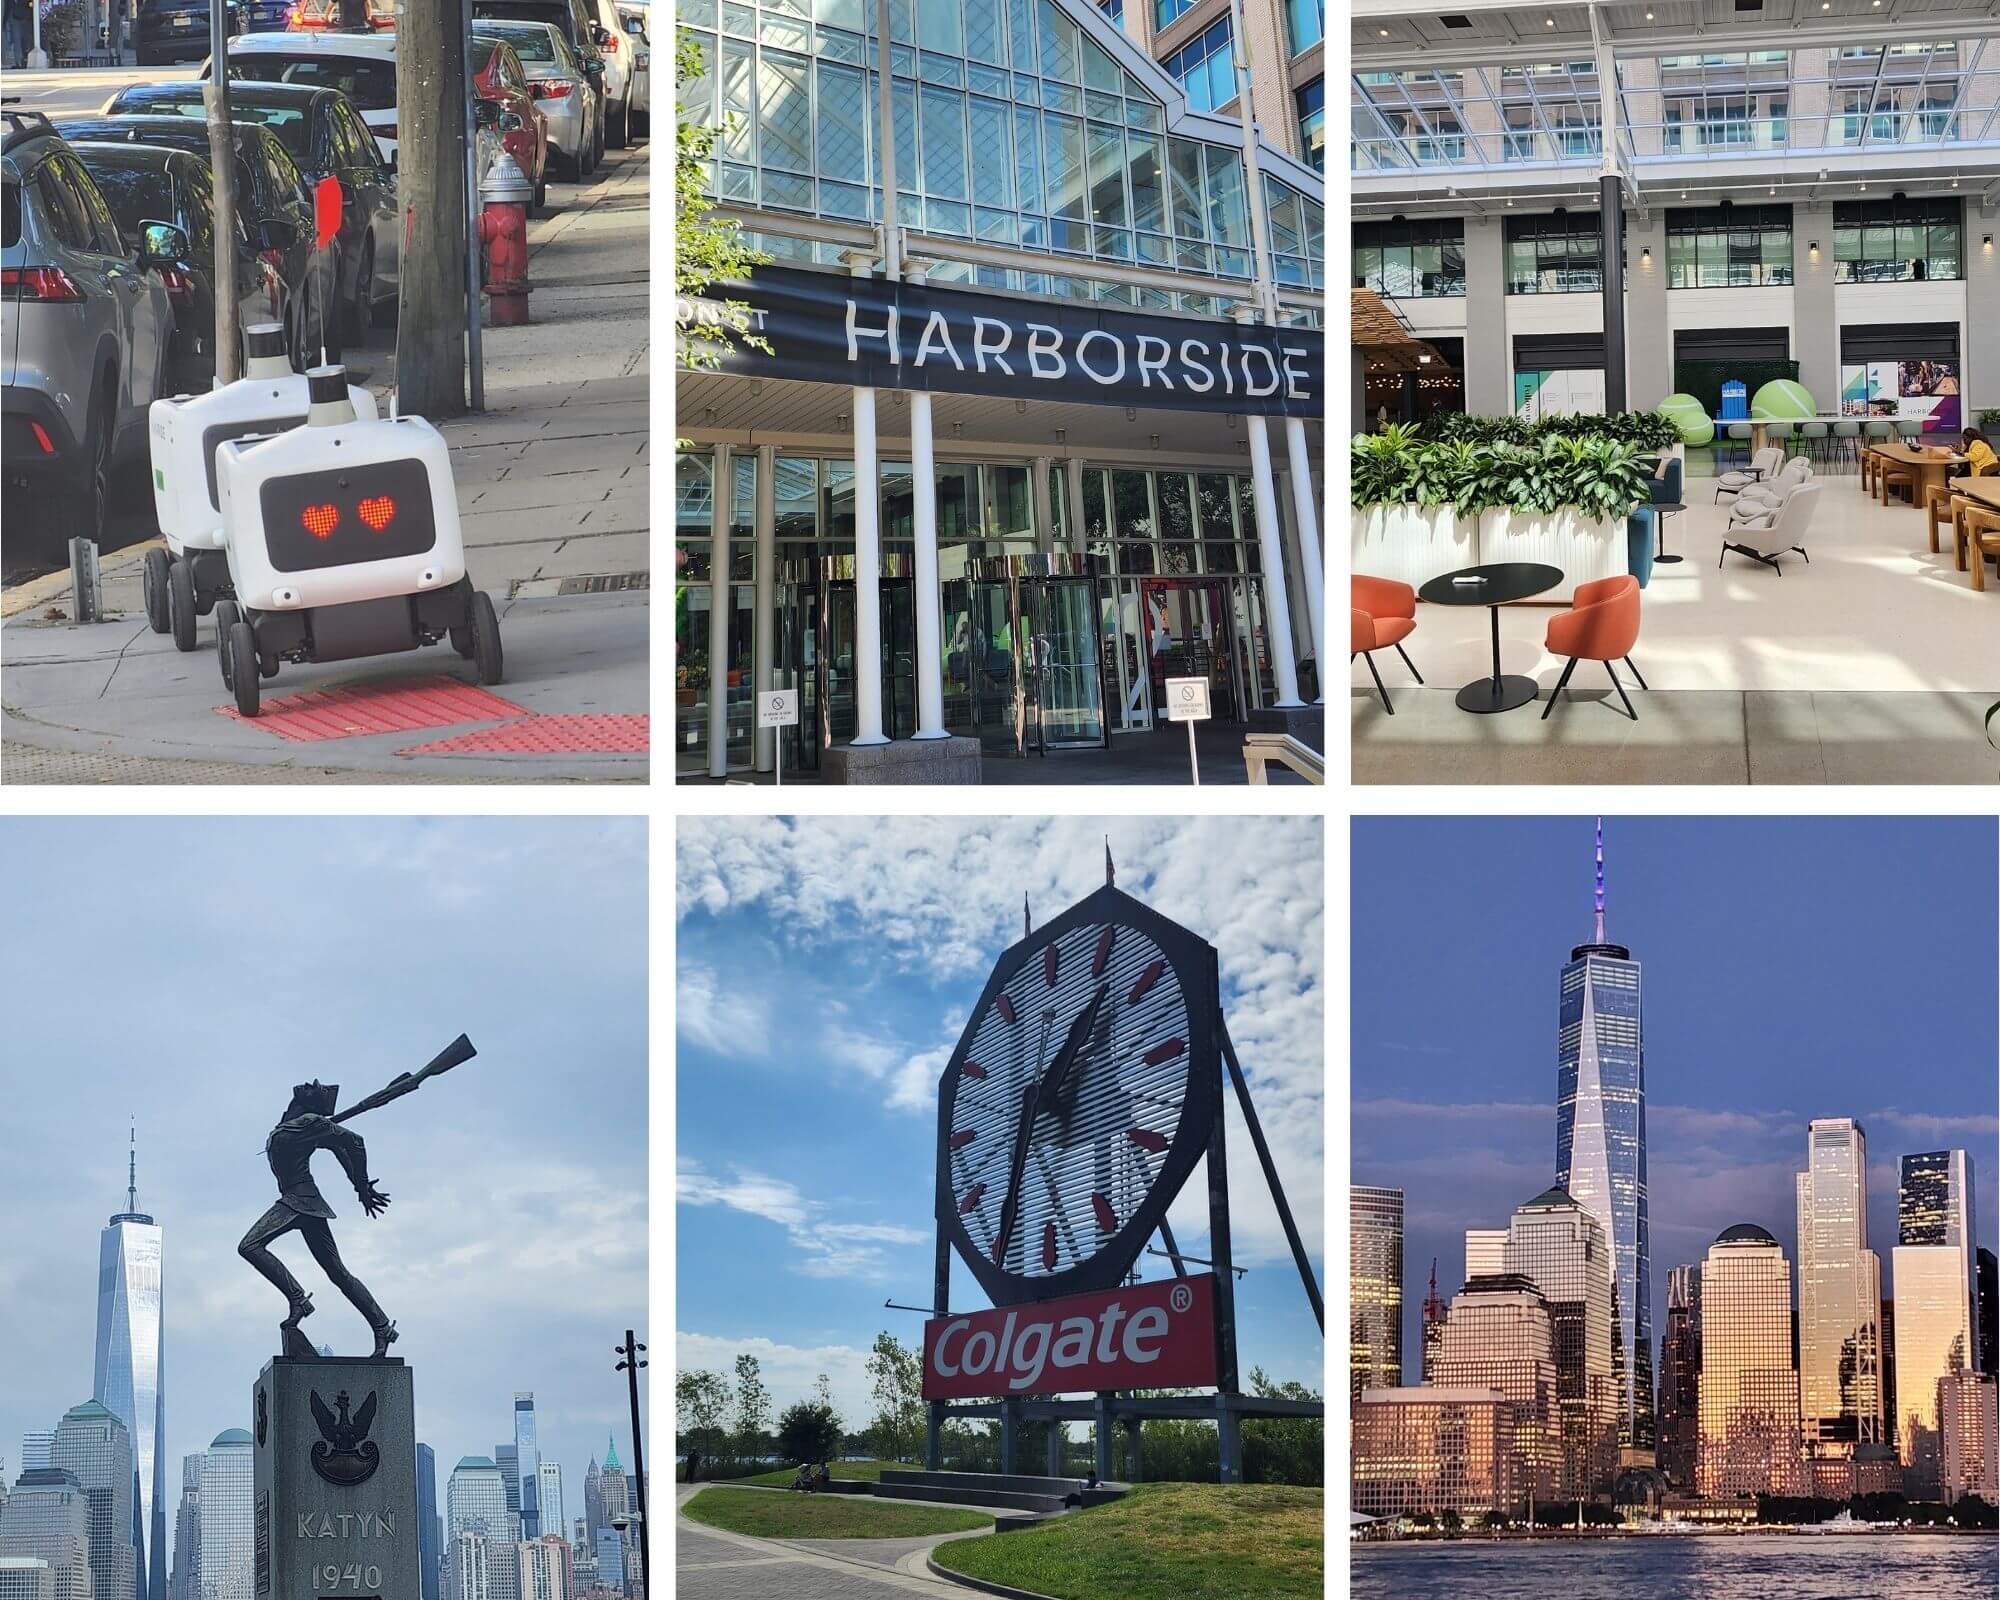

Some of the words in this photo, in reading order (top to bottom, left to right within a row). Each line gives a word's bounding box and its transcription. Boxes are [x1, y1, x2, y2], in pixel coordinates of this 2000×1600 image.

[846, 300, 1312, 400] HARBORSIDE
[934, 1302, 1169, 1389] Colgate
[297, 1506, 396, 1538] KATYŃ
[312, 1562, 383, 1590] 1940
